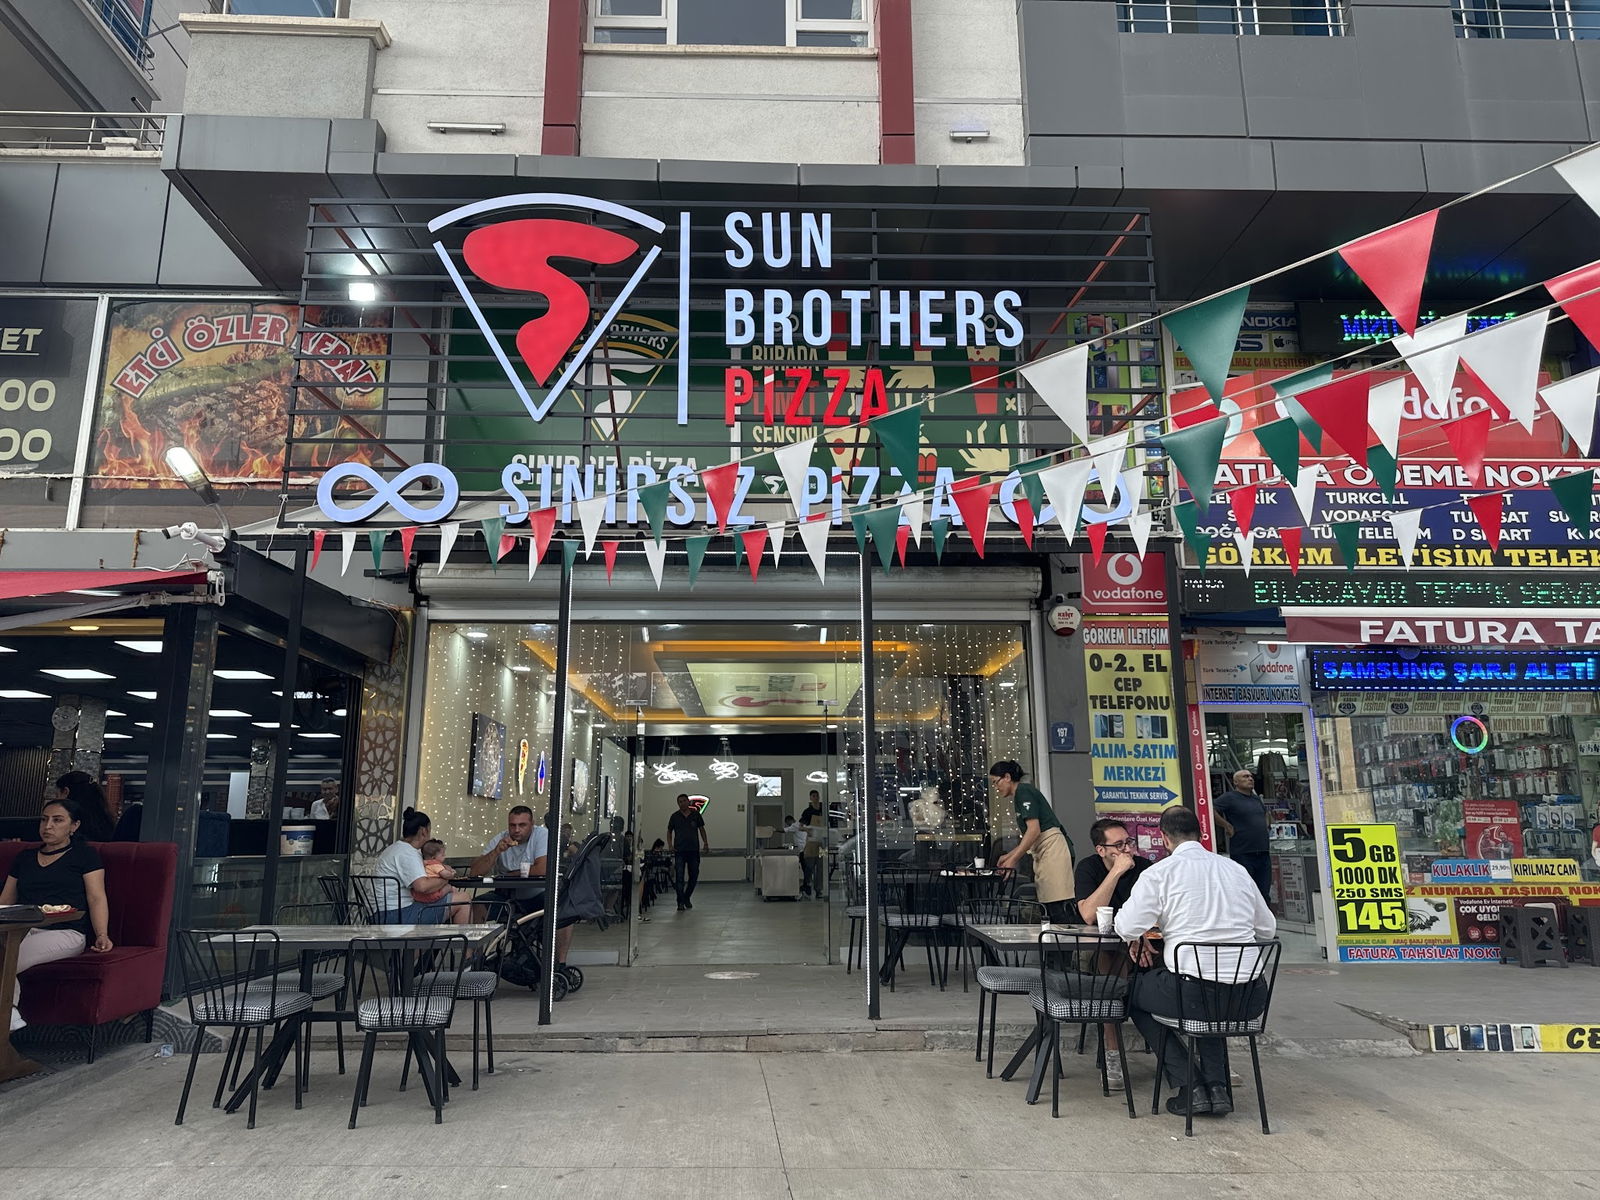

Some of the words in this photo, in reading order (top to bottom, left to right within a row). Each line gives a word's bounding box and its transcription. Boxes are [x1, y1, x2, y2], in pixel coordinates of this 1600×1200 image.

[724, 211, 832, 268] SUN
[725, 289, 1024, 347] BROTHERS
[0, 327, 43, 351] ET
[183, 313, 289, 351] ÖZLER
[1092, 587, 1164, 600] vodafone
[1083, 624, 1126, 645] GÖRKEM
[1360, 620, 1545, 644] FATURA
[1142, 653, 1168, 672] EL
[1256, 661, 1294, 673] vodafone
[1323, 662, 1447, 679] SAMSUNG
[1453, 662, 1517, 683] ŞARJ
[1523, 657, 1595, 680] ALETİ
[1114, 677, 1142, 692] CEP
[1090, 695, 1170, 710] TELEFONU
[1091, 743, 1178, 759] ALIM-SATIM
[1104, 762, 1166, 782] MERKEZİ
[1331, 828, 1367, 863] 5
[1369, 845, 1396, 863] GB
[1336, 867, 1374, 885] 1000
[1378, 867, 1399, 884] DK
[1432, 863, 1491, 877] KULAKLIK
[1513, 864, 1556, 876] KIRILMAZ
[1557, 864, 1578, 876] CAM
[1336, 889, 1367, 898] 250
[1370, 888, 1404, 898] SMS
[1420, 886, 1496, 896] NUMARA
[1499, 886, 1564, 898] TAŞIMA
[1460, 905, 1478, 915] ÇOK
[1348, 947, 1397, 959] FATURA
[1401, 945, 1460, 959] TAHSİLAT
